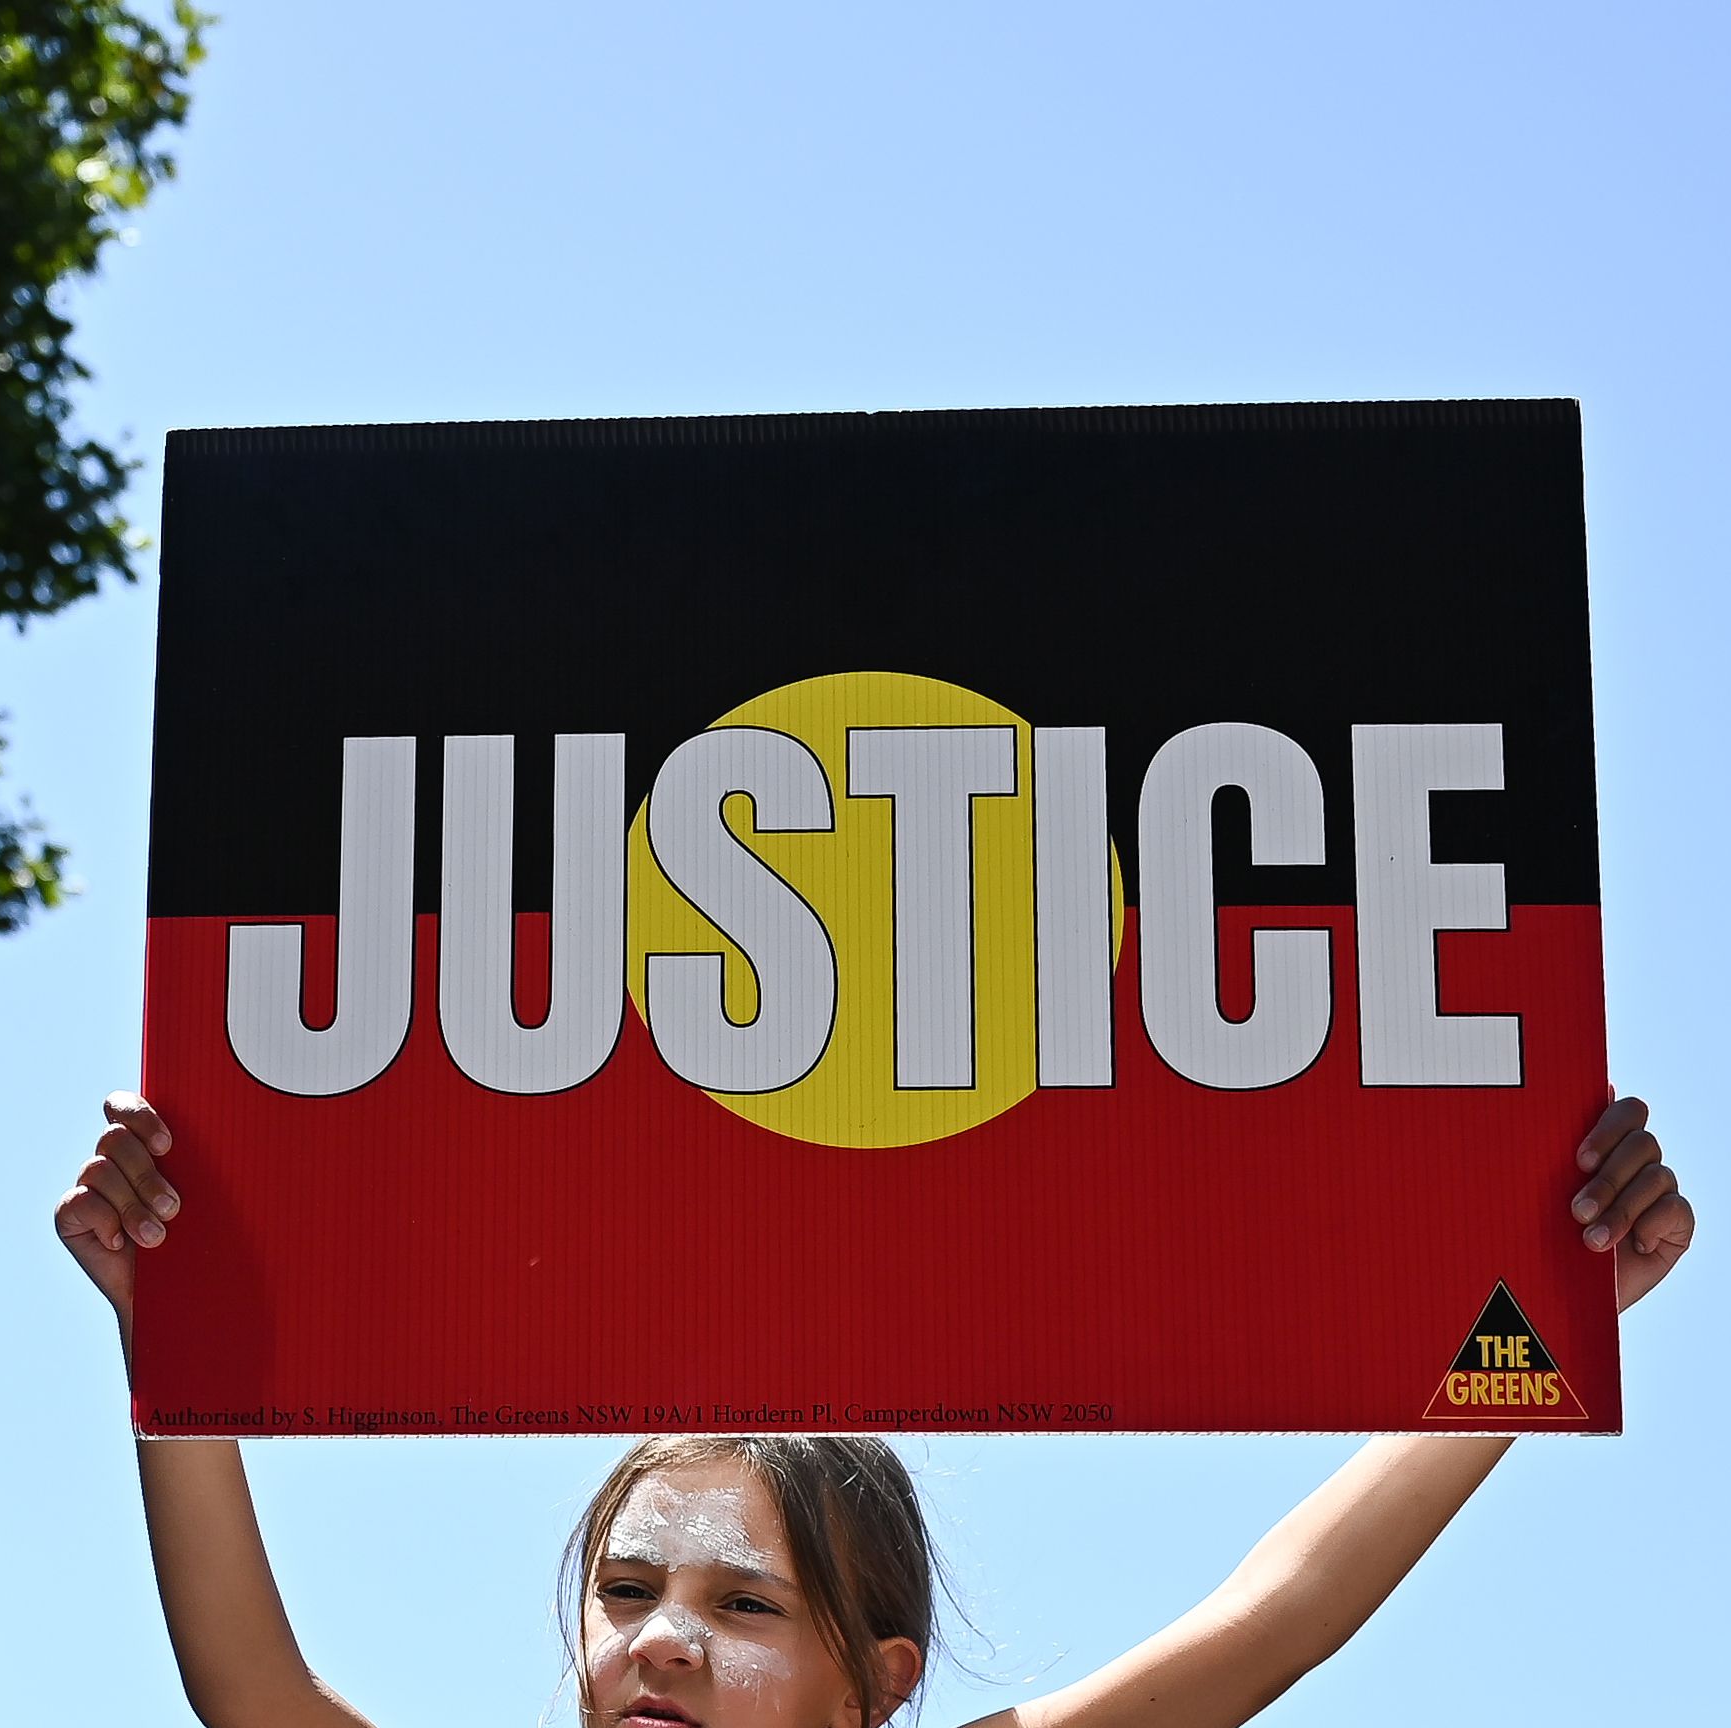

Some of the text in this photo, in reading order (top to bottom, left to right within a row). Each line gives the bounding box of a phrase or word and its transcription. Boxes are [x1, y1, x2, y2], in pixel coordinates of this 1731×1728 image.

[225, 722, 1523, 1098] JUSTICE
[1475, 1335, 1531, 1369] THE
[1445, 1372, 1561, 1406] GREENS
[148, 1402, 1113, 1431] Authorised by S. Higginson, The Greens NSW 19A/1 Hordern Pl, Camperdown NSW 2050
